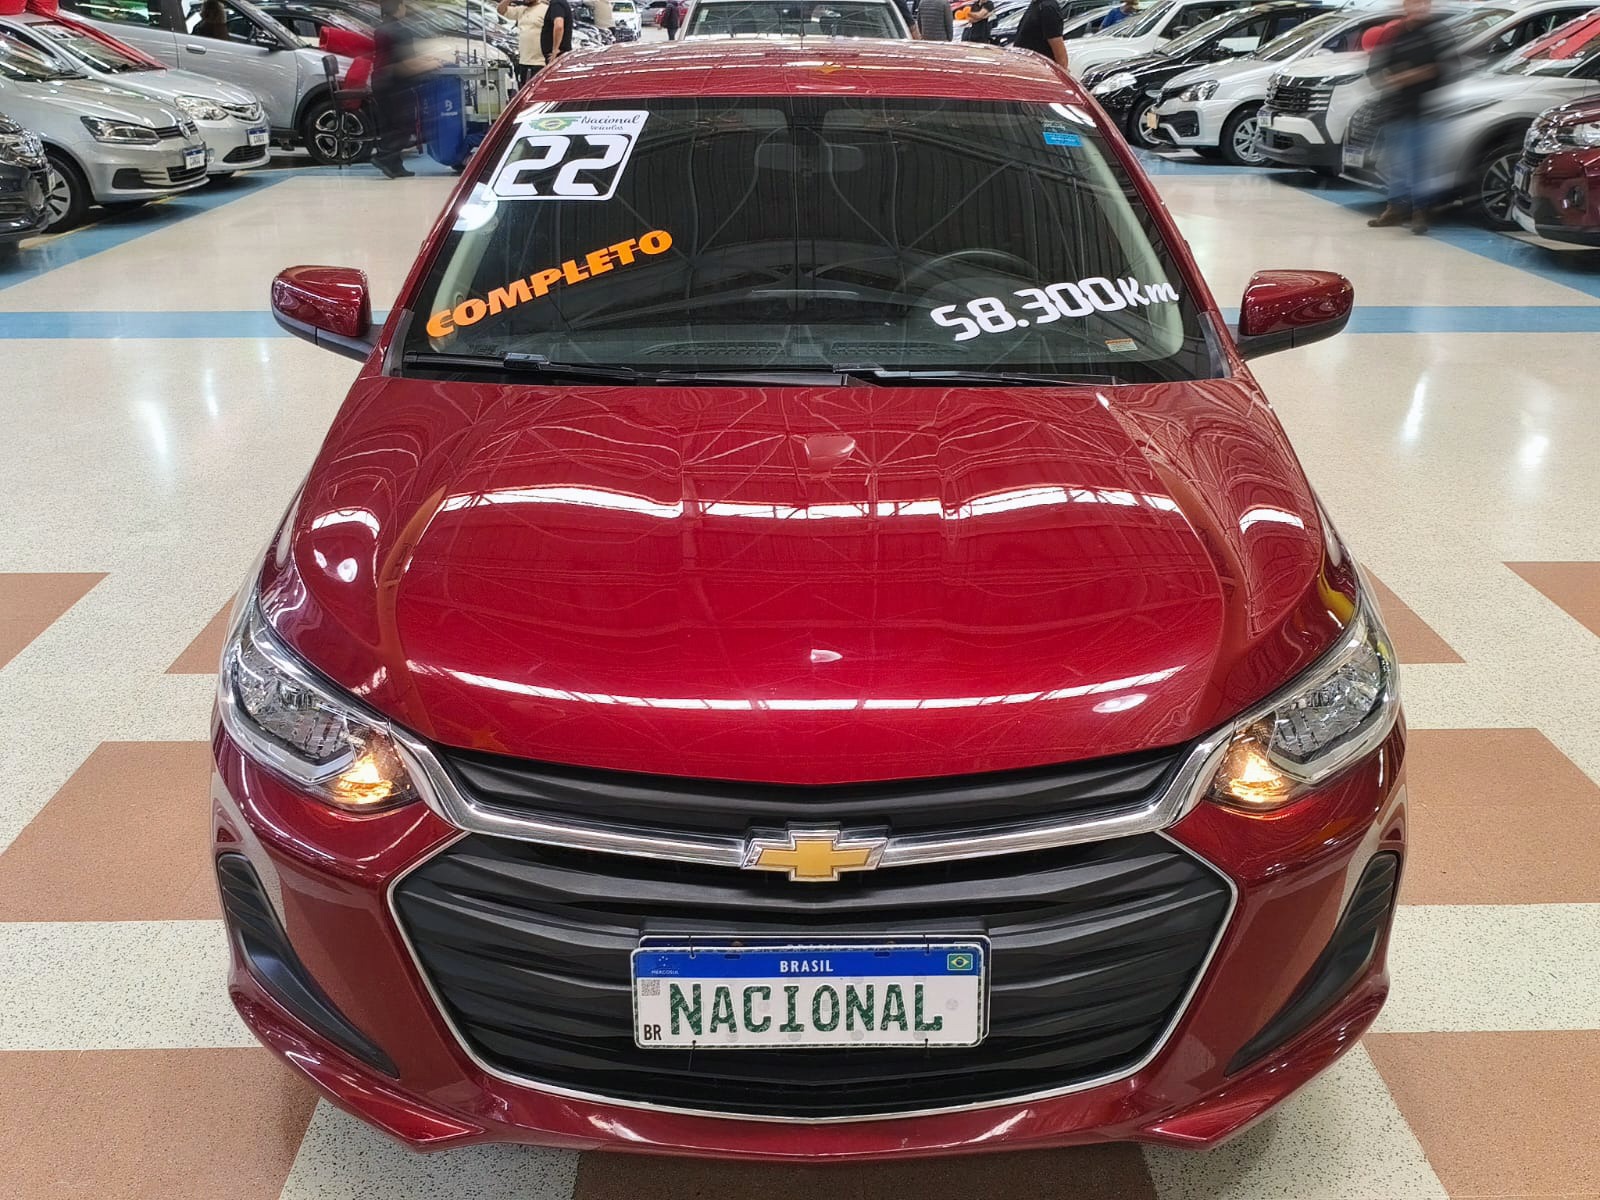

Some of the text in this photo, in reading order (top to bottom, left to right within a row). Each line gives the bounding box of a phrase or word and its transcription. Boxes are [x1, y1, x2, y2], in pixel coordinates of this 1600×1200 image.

[581, 114, 641, 124] Nacional
[494, 134, 629, 195] 22
[426, 230, 673, 338] COMPLETO
[779, 959, 834, 973] BRASIL
[668, 983, 943, 1035] NACIONAL
[643, 1024, 662, 1041] BR
